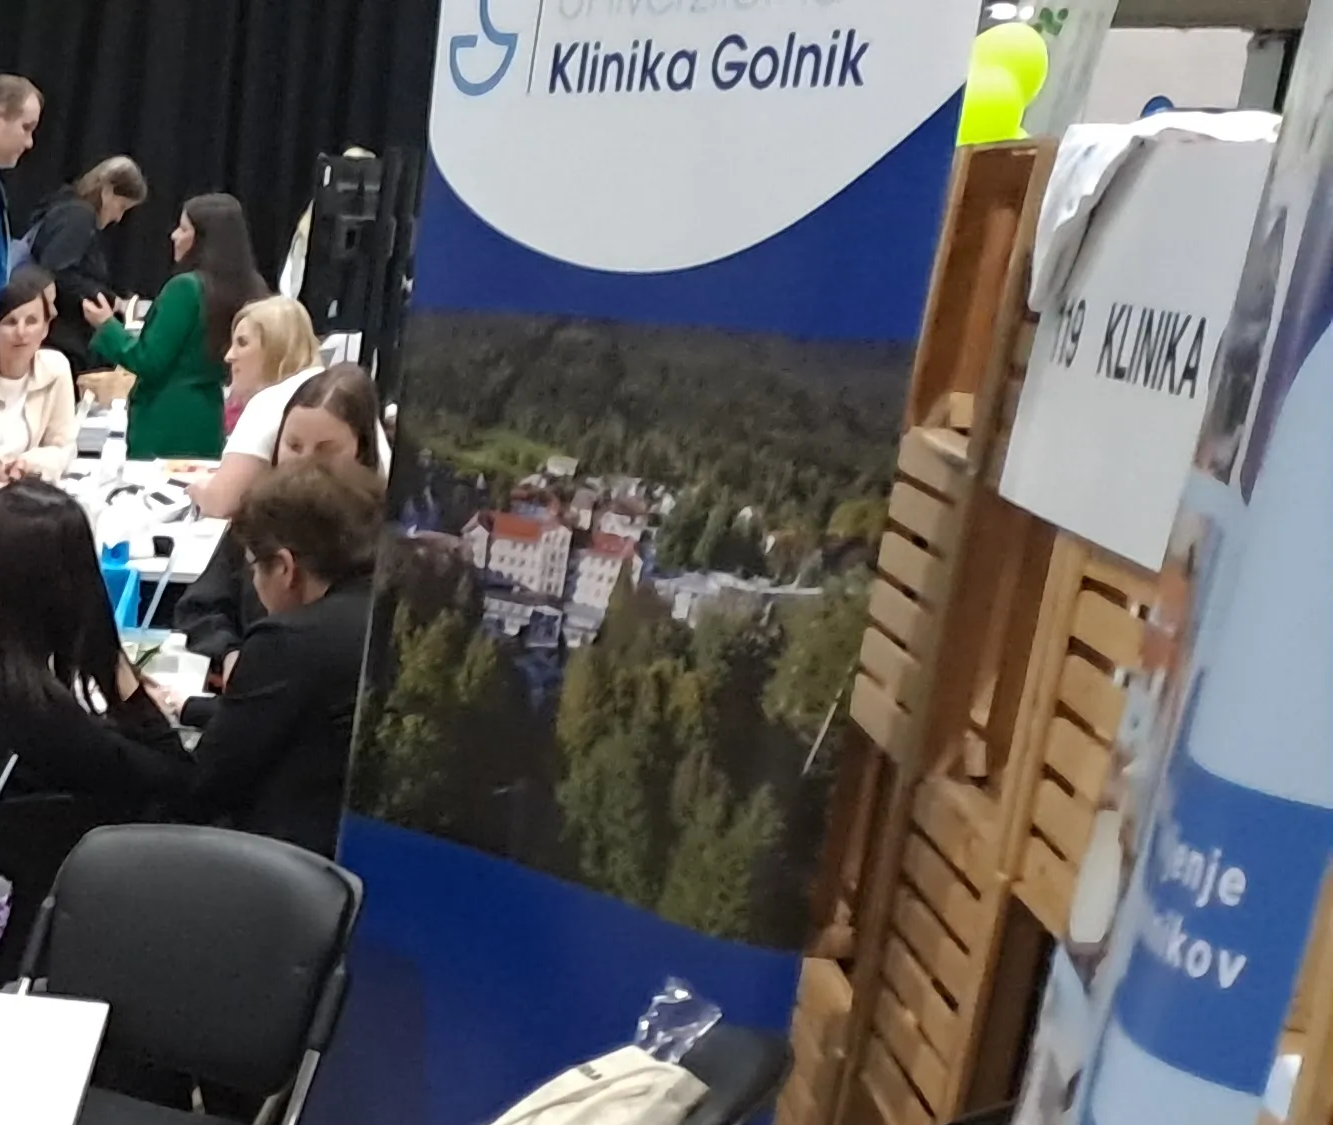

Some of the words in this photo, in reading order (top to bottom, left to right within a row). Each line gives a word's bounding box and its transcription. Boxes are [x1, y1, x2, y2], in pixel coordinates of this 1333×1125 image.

[548, 37, 699, 94] Klinika
[711, 28, 870, 91] Golnik
[1096, 302, 1208, 399] KLINIKA
